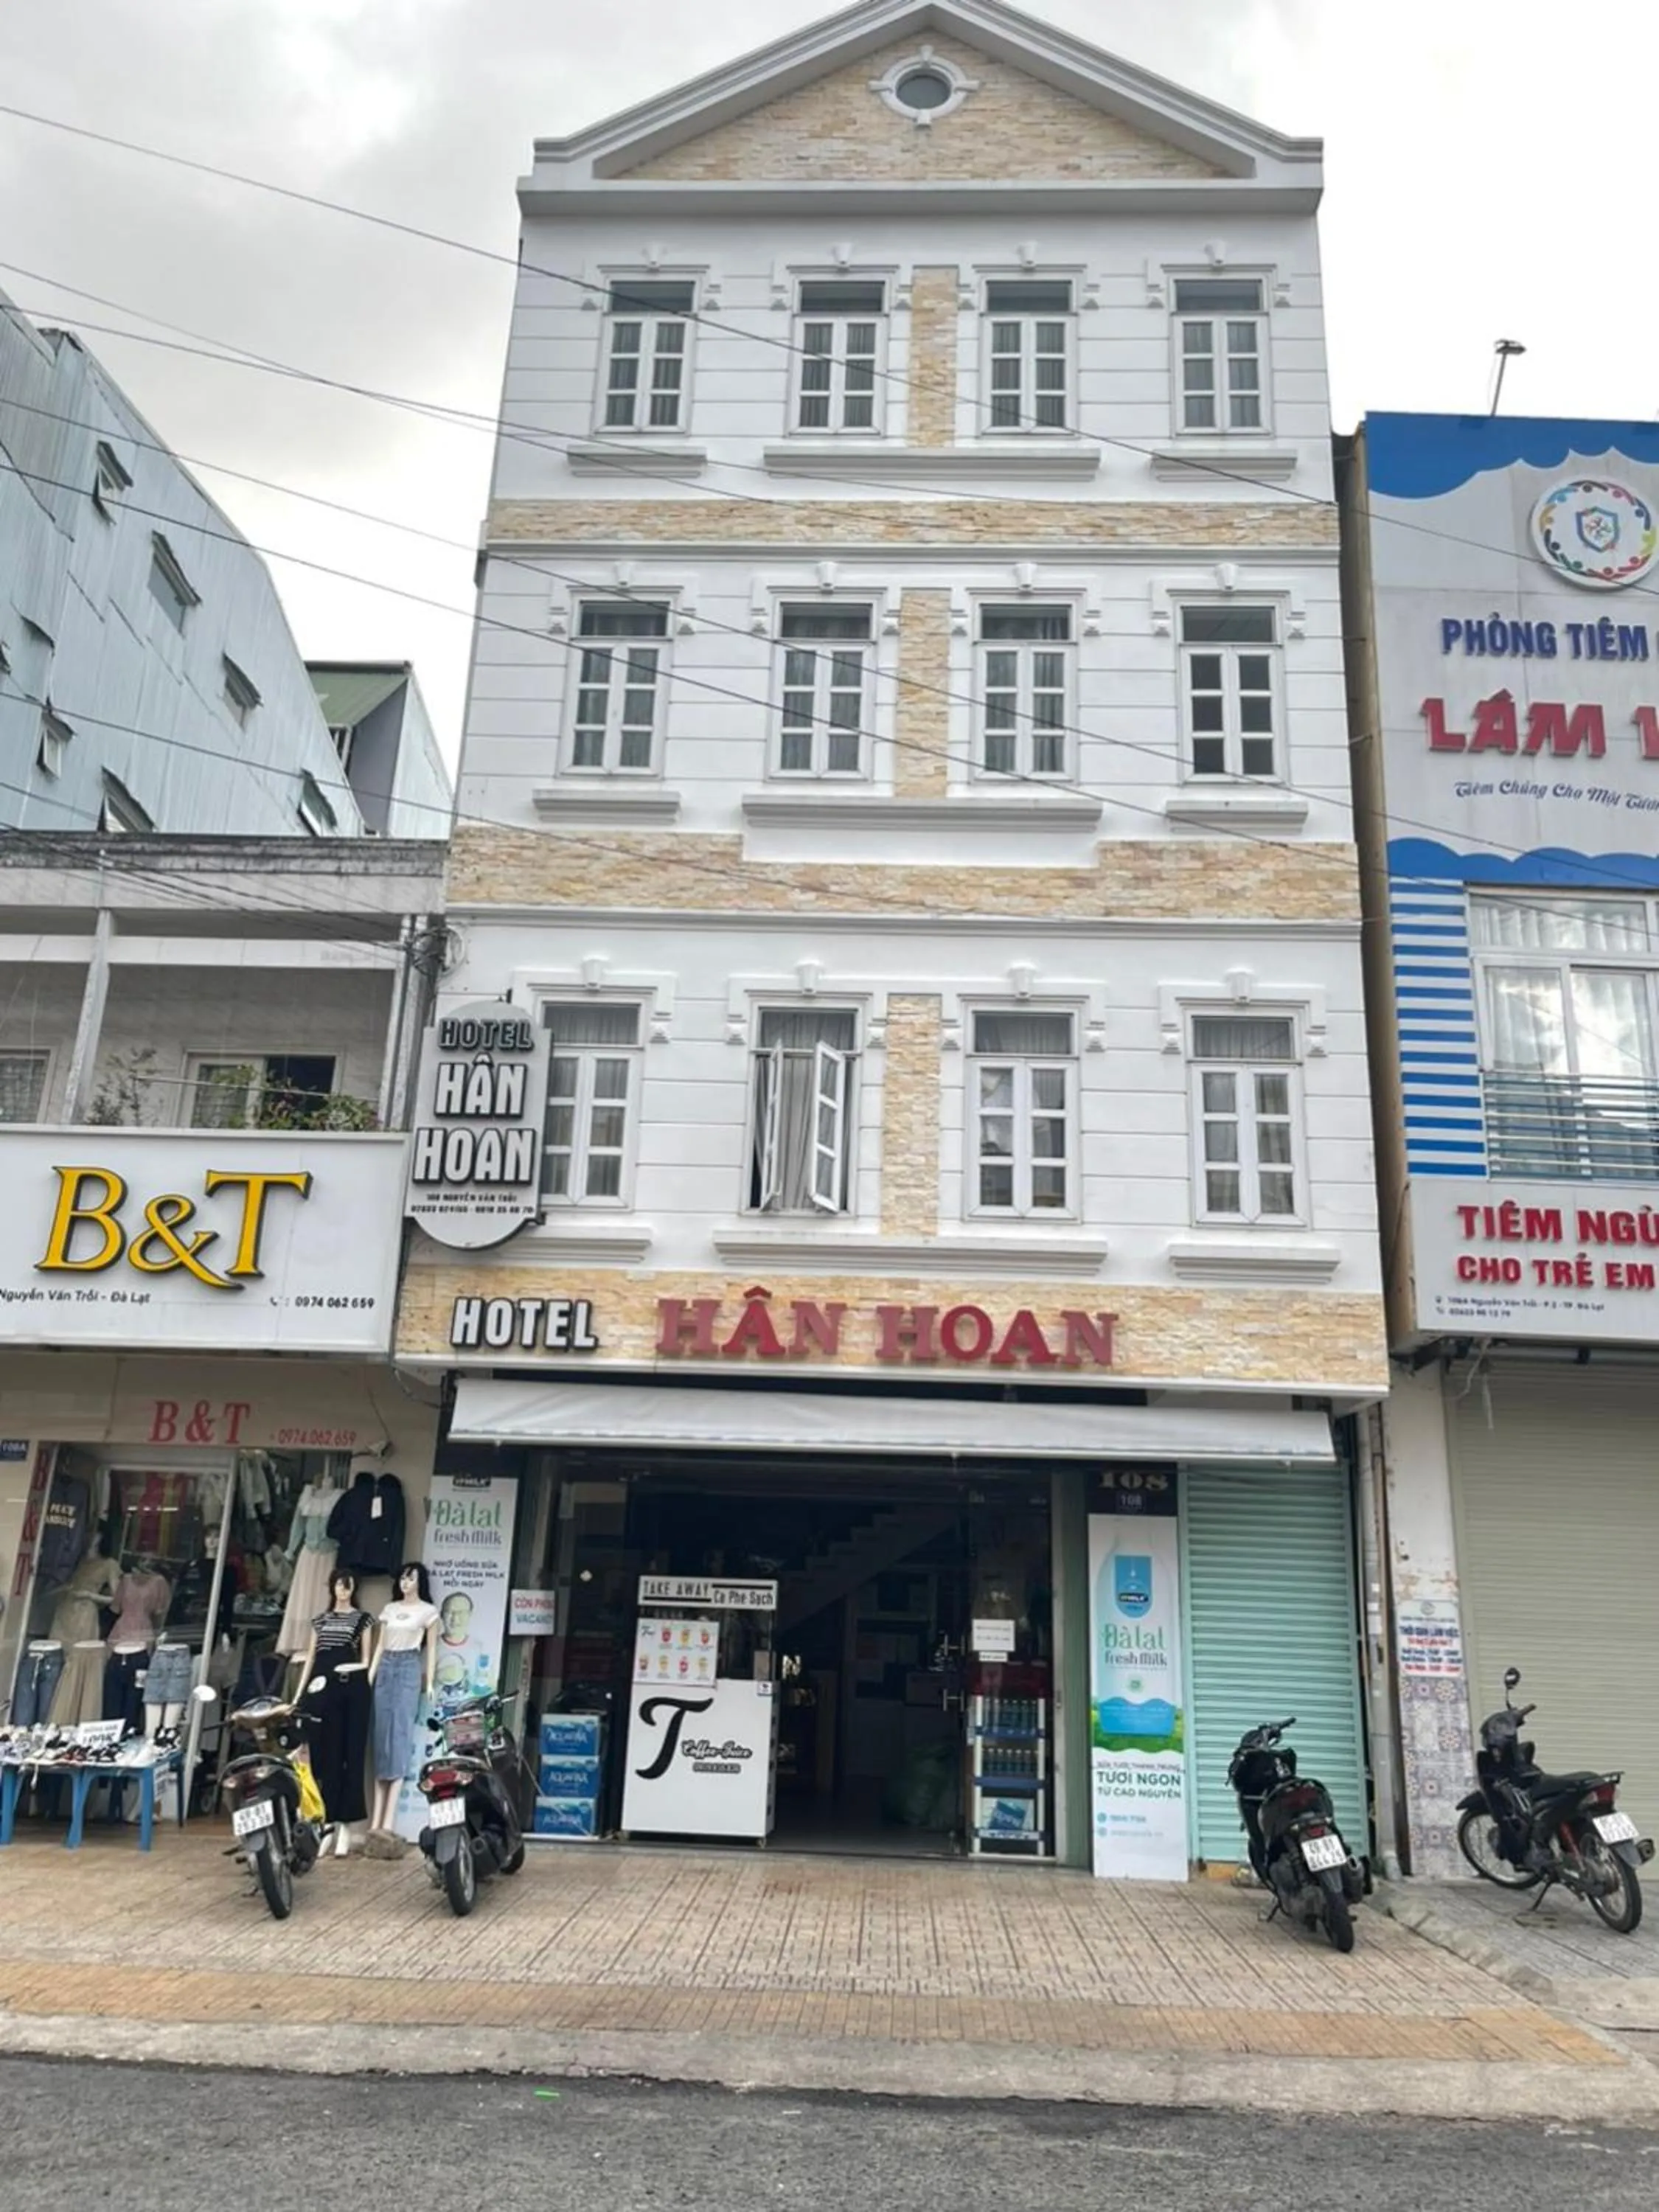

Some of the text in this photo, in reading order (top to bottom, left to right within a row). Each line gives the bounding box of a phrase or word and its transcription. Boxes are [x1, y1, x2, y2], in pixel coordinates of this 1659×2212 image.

[1565, 616, 1649, 661] TIÊM
[1419, 688, 1606, 758] LÂM
[438, 1018, 534, 1051] HOTEL
[434, 1051, 528, 1119] HÂN
[412, 1127, 536, 1186] HOAN
[34, 1166, 313, 1290] B&T
[1456, 1200, 1563, 1242] TIÊM
[1457, 1255, 1522, 1284] CHO
[1605, 1262, 1655, 1290] EM
[295, 1296, 324, 1307] 0974
[451, 1285, 1119, 1366] HOTEL HÂN HOAN
[644, 1580, 709, 1596] TAKE AWAY
[1097, 1771, 1180, 1786] TƯƠI NGON
[1113, 1787, 1136, 1798] CAO
